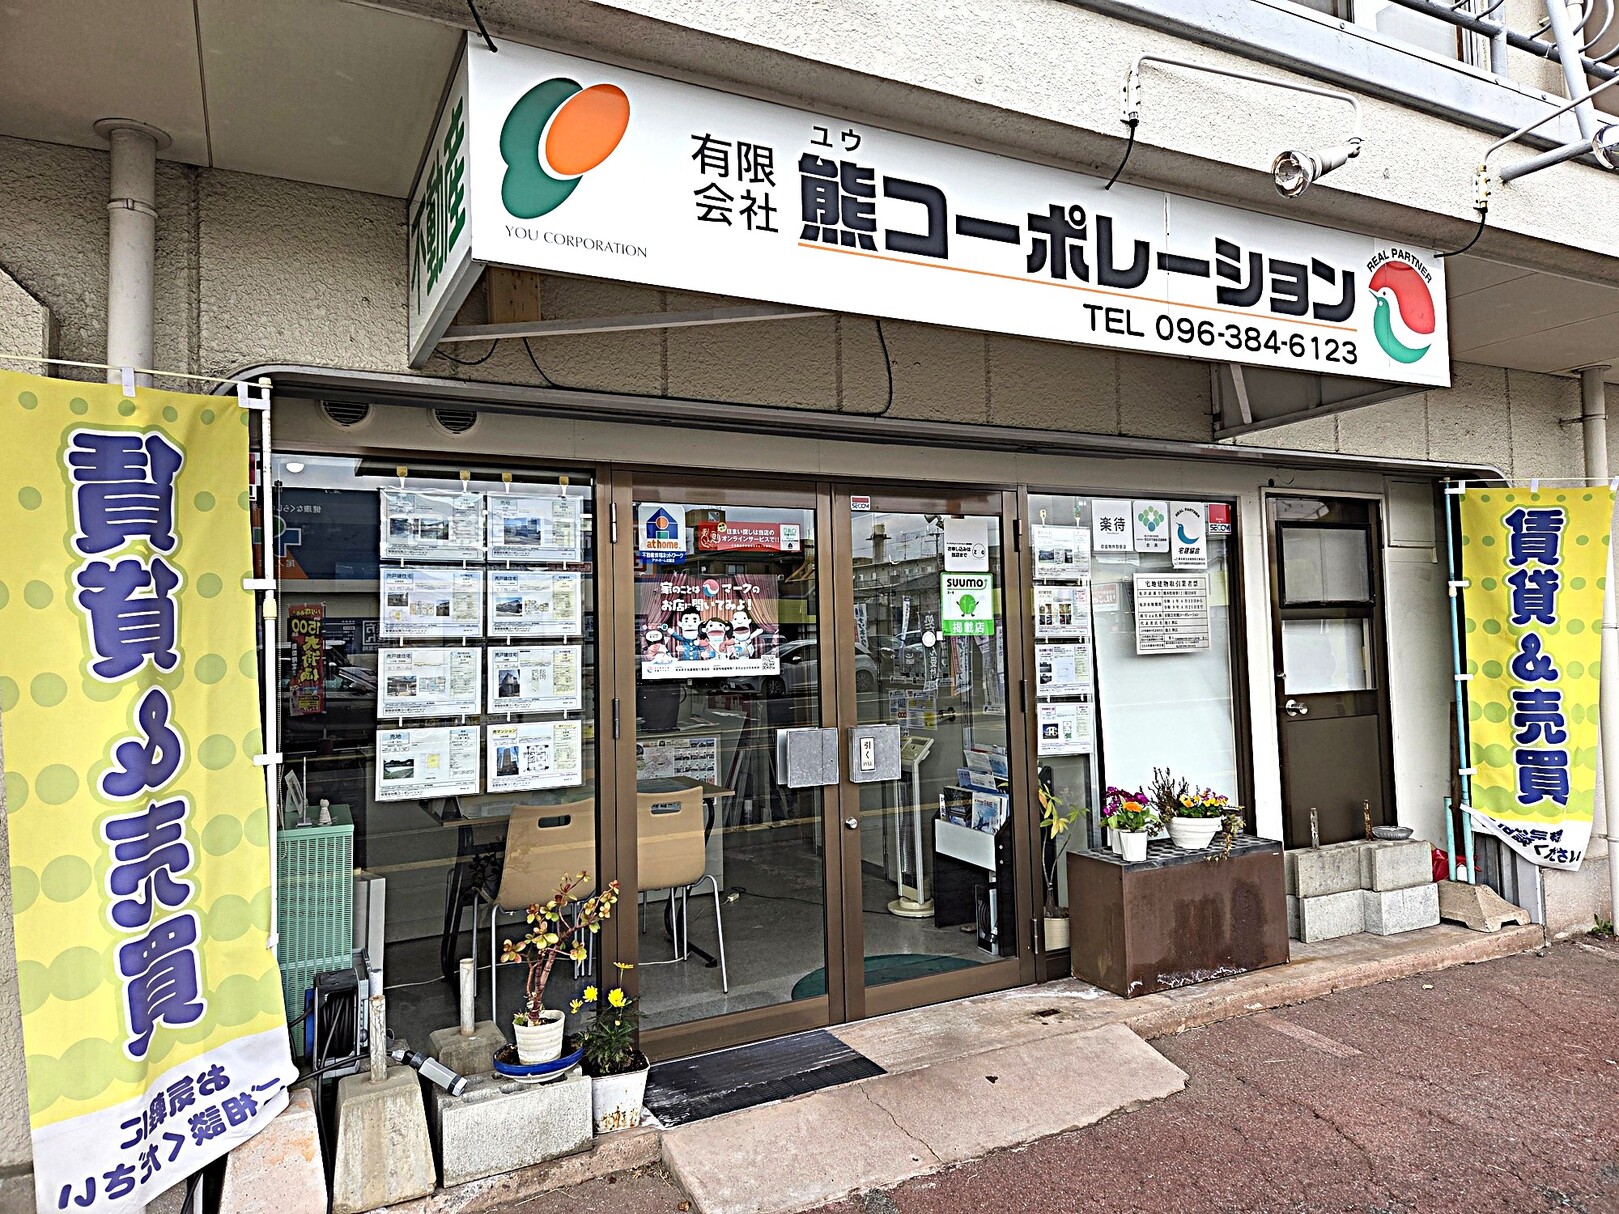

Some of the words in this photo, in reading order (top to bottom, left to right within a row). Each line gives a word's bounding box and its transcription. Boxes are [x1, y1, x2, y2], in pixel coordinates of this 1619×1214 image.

[810, 125, 863, 151] ユウ
[690, 133, 776, 187] 有限
[693, 182, 779, 233] 会社
[505, 225, 540, 242] YOU
[543, 231, 647, 258] CORPORATION
[798, 154, 1356, 322] 熊コーポレーション
[1367, 250, 1389, 272] REAL
[1391, 248, 1432, 284] PARTNER
[1083, 304, 1144, 337] TEL
[1155, 315, 1358, 364] 096-384-6123
[1099, 516, 1126, 532] 楽待
[660, 581, 700, 595] 家のことは
[722, 584, 760, 595] マークの
[946, 578, 984, 588] SUUMO
